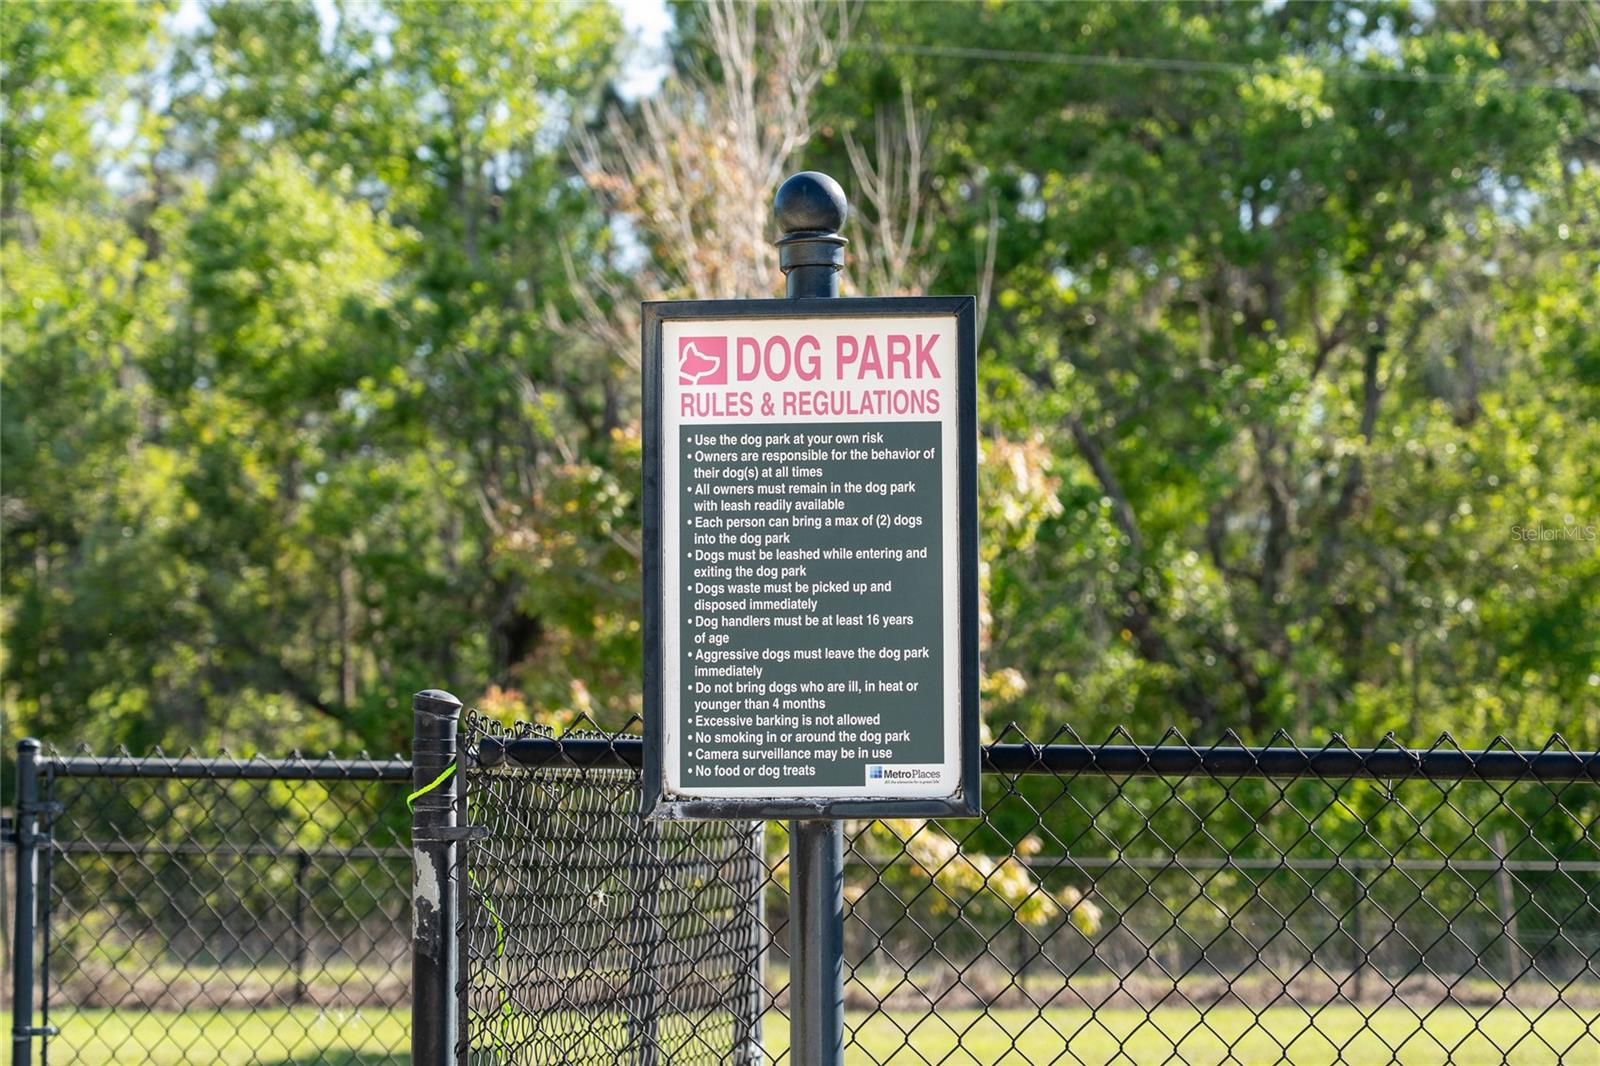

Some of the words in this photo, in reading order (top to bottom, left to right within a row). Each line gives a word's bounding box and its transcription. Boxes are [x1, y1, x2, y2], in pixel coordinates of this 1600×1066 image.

[737, 335, 822, 381] DOG
[836, 334, 942, 380] PARK
[681, 392, 753, 416] RULES
[761, 392, 775, 416] &
[783, 389, 940, 416] REGULATIONS
[695, 434, 717, 446] Use
[719, 434, 738, 446] the
[740, 433, 762, 448] dog
[765, 433, 791, 448] park
[793, 433, 804, 445] at
[807, 435, 833, 447] your
[835, 434, 859, 444] own
[862, 432, 884, 444] risk
[694, 450, 738, 462] Owners
[740, 452, 759, 462] are
[762, 449, 828, 464] responsible
[831, 449, 847, 461] for
[850, 448, 868, 460] the
[871, 448, 921, 460] behavior
[923, 447, 935, 459] of
[693, 466, 720, 479] their
[722, 466, 759, 481] dog(s)
[761, 467, 773, 478] at
[775, 466, 789, 478] all
[791, 466, 823, 478] times
[694, 483, 710, 495] All
[713, 485, 754, 495] owners
[757, 483, 786, 494] must
[788, 482, 827, 494] remain
[830, 482, 841, 493] in
[844, 481, 862, 493] the
[865, 481, 887, 496] dog
[890, 481, 916, 496] park
[693, 499, 718, 512] with
[721, 499, 751, 511] leash
[754, 498, 792, 514] readily
[794, 498, 845, 510] available
[695, 516, 723, 528] Each
[726, 518, 766, 530] person
[768, 518, 789, 527] can
[792, 515, 822, 530] bring
[824, 517, 832, 527] a
[835, 517, 859, 526] max
[861, 514, 874, 526] of
[876, 514, 891, 529] (2)
[894, 514, 923, 529] dogs
[694, 532, 716, 544] into
[718, 532, 737, 544] the
[740, 532, 762, 547] dog
[765, 532, 790, 547] park
[695, 549, 725, 564] Dogs
[728, 549, 756, 561] must
[759, 548, 773, 560] be
[776, 548, 820, 560] leashed
[822, 547, 853, 560] while
[855, 547, 903, 562] entering
[905, 547, 927, 559] and
[694, 565, 732, 580] exiting
[735, 565, 754, 577] the
[756, 565, 778, 580] dog
[781, 564, 807, 579] park
[695, 582, 725, 596] Dogs
[727, 582, 761, 594] waste
[764, 582, 792, 593] must
[795, 581, 809, 593] be
[812, 581, 850, 596] picked
[853, 583, 868, 595] up
[870, 580, 892, 592] and
[694, 598, 746, 613] disposed
[749, 597, 818, 612] immediately
[695, 615, 718, 630] Dog
[721, 615, 771, 627] handlers
[774, 615, 802, 626] must
[805, 614, 819, 626] be
[822, 614, 833, 626] at
[836, 614, 863, 626] least
[866, 614, 880, 626] 16
[882, 615, 914, 628] years
[694, 632, 706, 644] of
[708, 634, 730, 646] age
[695, 648, 759, 663] Aggressive
[762, 648, 791, 662] dogs
[793, 648, 822, 659] must
[825, 647, 855, 659] leave
[857, 647, 876, 659] the
[878, 646, 901, 662] dog
[904, 646, 930, 661] park
[694, 665, 763, 679] immediately
[695, 682, 711, 693] Do
[714, 682, 733, 693] not
[736, 681, 766, 696] bring
[768, 681, 798, 696] dogs
[800, 681, 824, 692] who
[827, 683, 846, 692] are
[848, 680, 862, 694] ill,
[865, 680, 875, 692] in
[878, 680, 904, 692] heat
[906, 682, 919, 692] or
[694, 700, 742, 713] younger
[744, 698, 770, 710] than
[772, 698, 780, 709] 4
[782, 697, 826, 709] months
[696, 714, 753, 727] Excessive
[756, 714, 799, 729] barking
[802, 714, 812, 726] is
[815, 714, 834, 726] not
[836, 713, 880, 726] allowed
[695, 732, 712, 744] No
[714, 731, 763, 746] smoking
[766, 731, 777, 743] in
[780, 733, 793, 743] or
[795, 730, 836, 743] around
[838, 730, 857, 742] the
[859, 730, 882, 745] dog
[884, 730, 910, 745] park
[695, 748, 739, 760] Camera
[742, 747, 811, 760] surveillance
[814, 749, 838, 762] may
[841, 747, 855, 759] be
[858, 746, 869, 758] in
[872, 749, 893, 759] use
[695, 765, 712, 777] No
[714, 764, 740, 776] food
[743, 767, 756, 776] or
[758, 764, 780, 779] dog
[782, 764, 816, 776] treats
[884, 769, 940, 778] MetroPlaces
